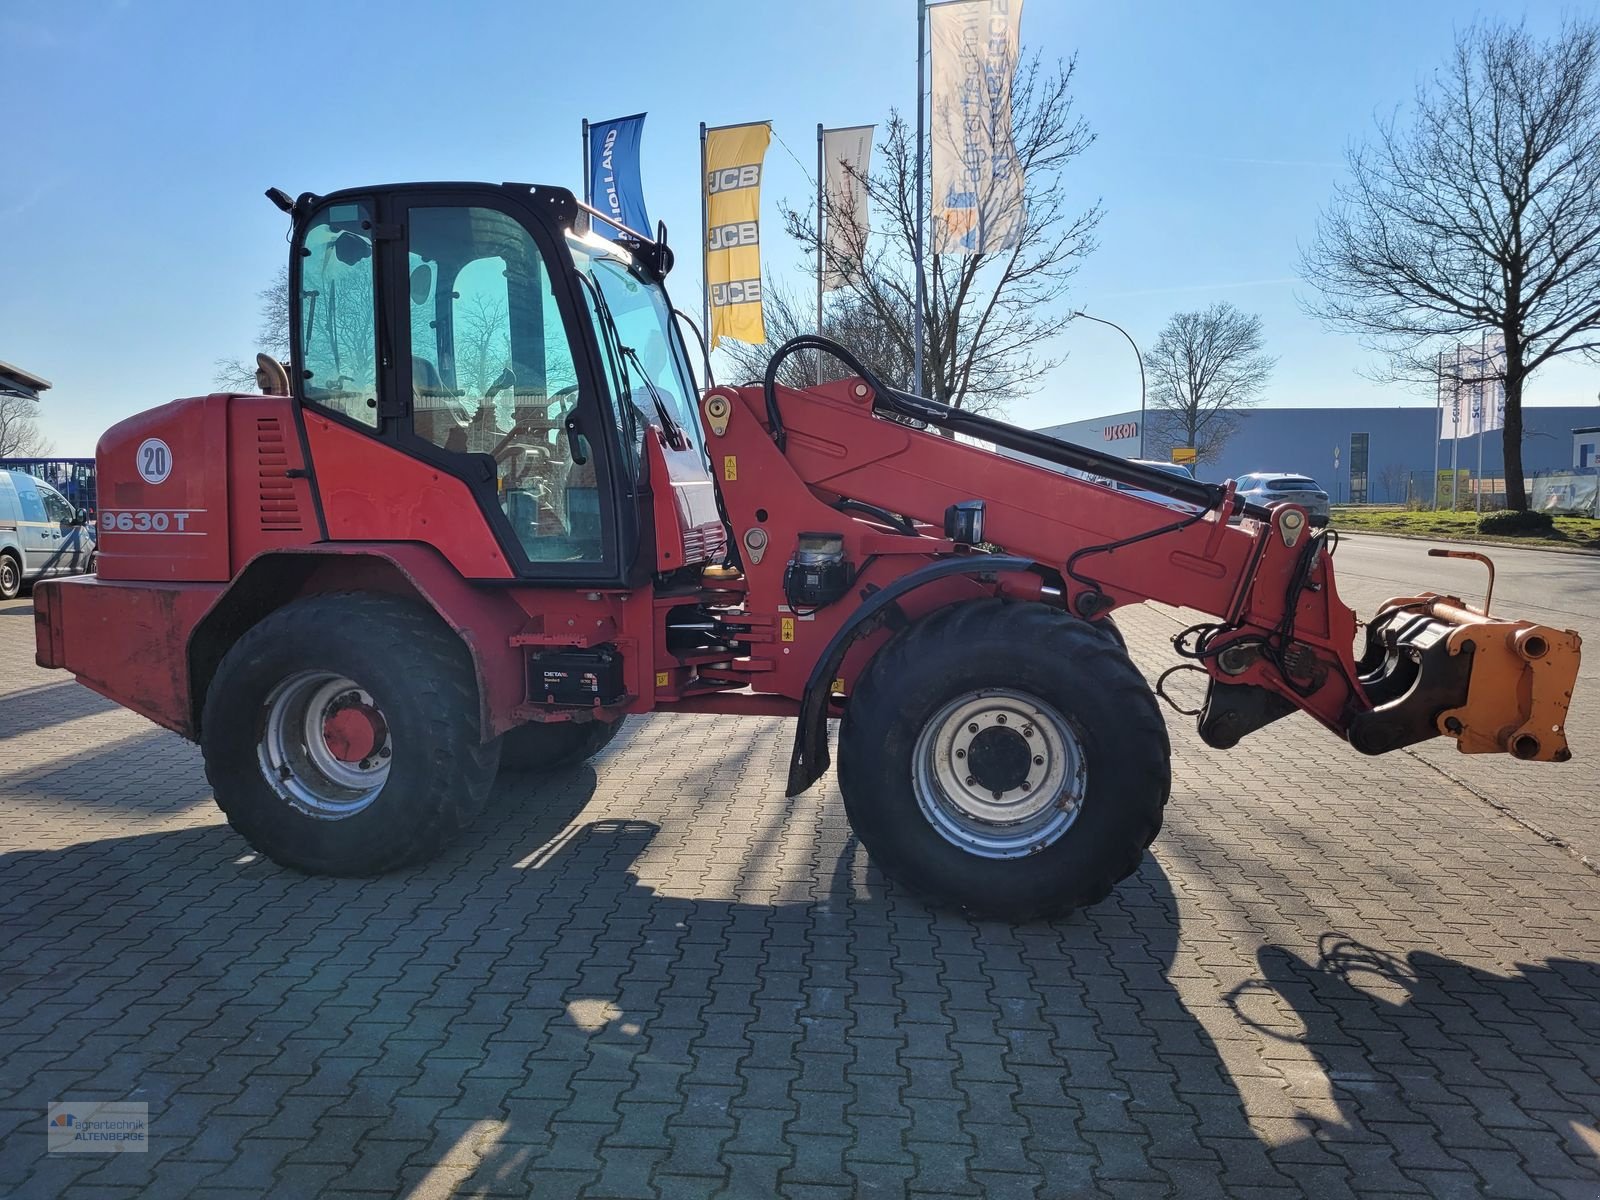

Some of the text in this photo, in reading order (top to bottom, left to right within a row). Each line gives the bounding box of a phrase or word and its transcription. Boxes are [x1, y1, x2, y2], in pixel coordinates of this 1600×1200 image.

[709, 165, 759, 193] JCB
[709, 223, 758, 250] JCB
[713, 281, 761, 306] JCB
[144, 447, 166, 475] 20
[102, 512, 189, 531] 9630 T
